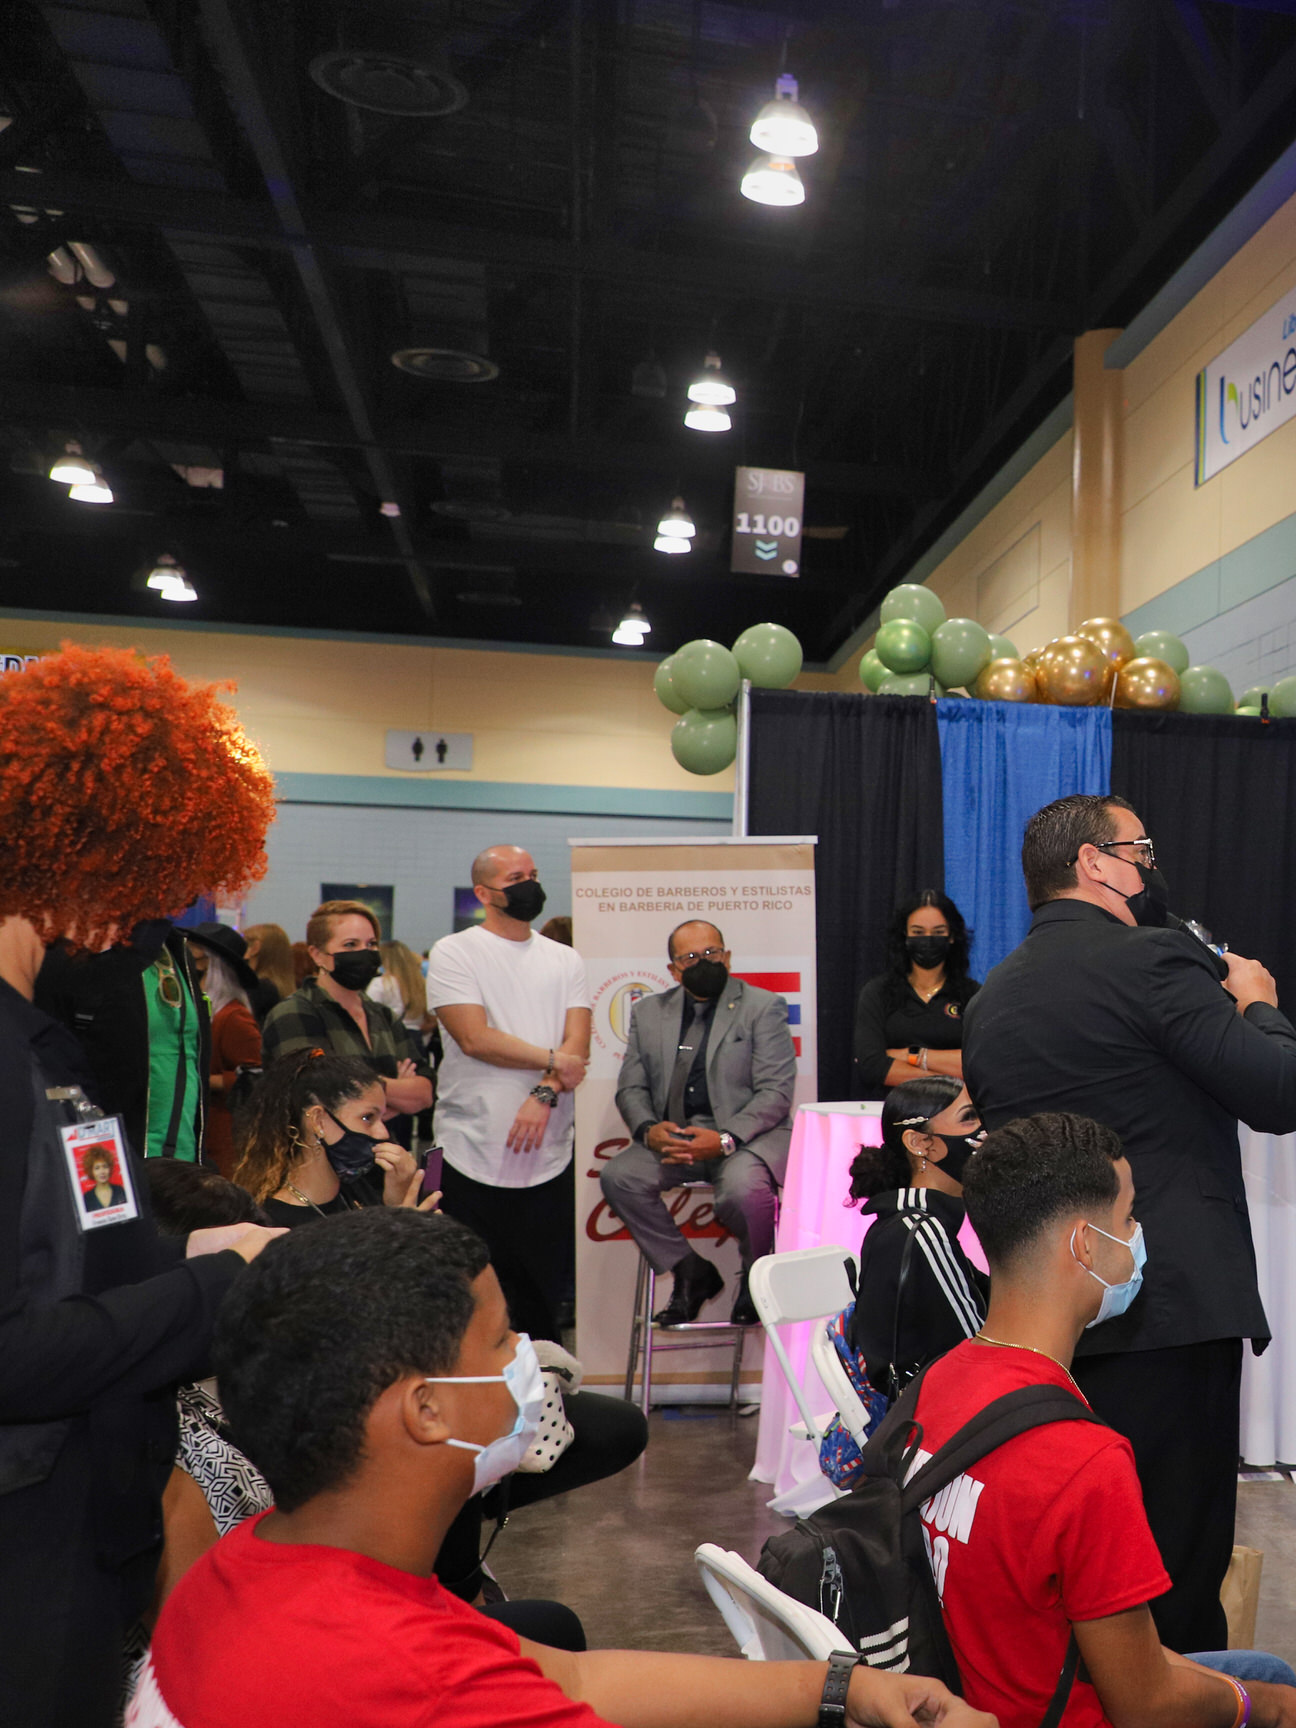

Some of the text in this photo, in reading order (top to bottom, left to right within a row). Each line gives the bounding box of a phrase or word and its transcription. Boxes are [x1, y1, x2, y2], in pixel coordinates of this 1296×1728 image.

[735, 512, 800, 538] 1100
[575, 885, 812, 899] COLEGIO DE BARBEROS Y ESTILISTAS
[598, 900, 793, 912] EN BARBERIA DE PUERTO RICO
